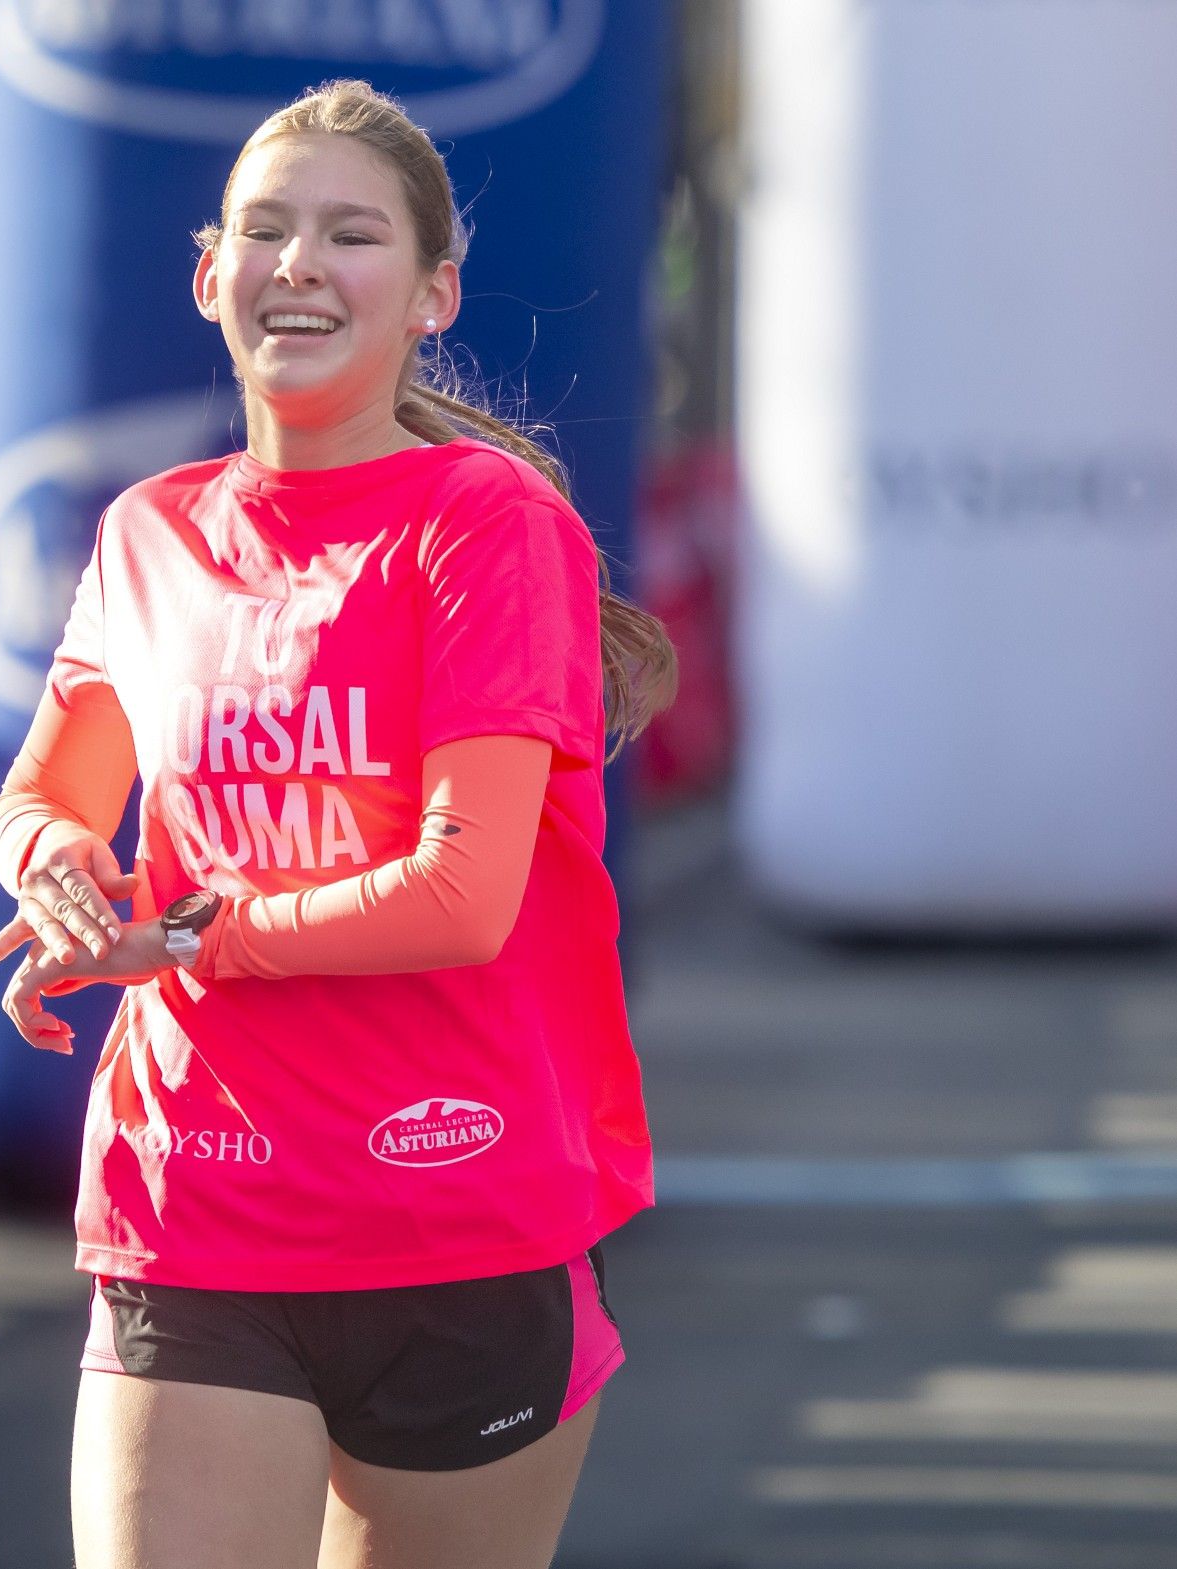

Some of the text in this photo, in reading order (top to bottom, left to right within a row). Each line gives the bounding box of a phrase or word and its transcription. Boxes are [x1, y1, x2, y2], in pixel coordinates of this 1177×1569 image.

[165, 683, 391, 777] ORSAL
[379, 1122, 495, 1155] ASTURIANA
[399, 1112, 489, 1133] CENTRAL LECHERA
